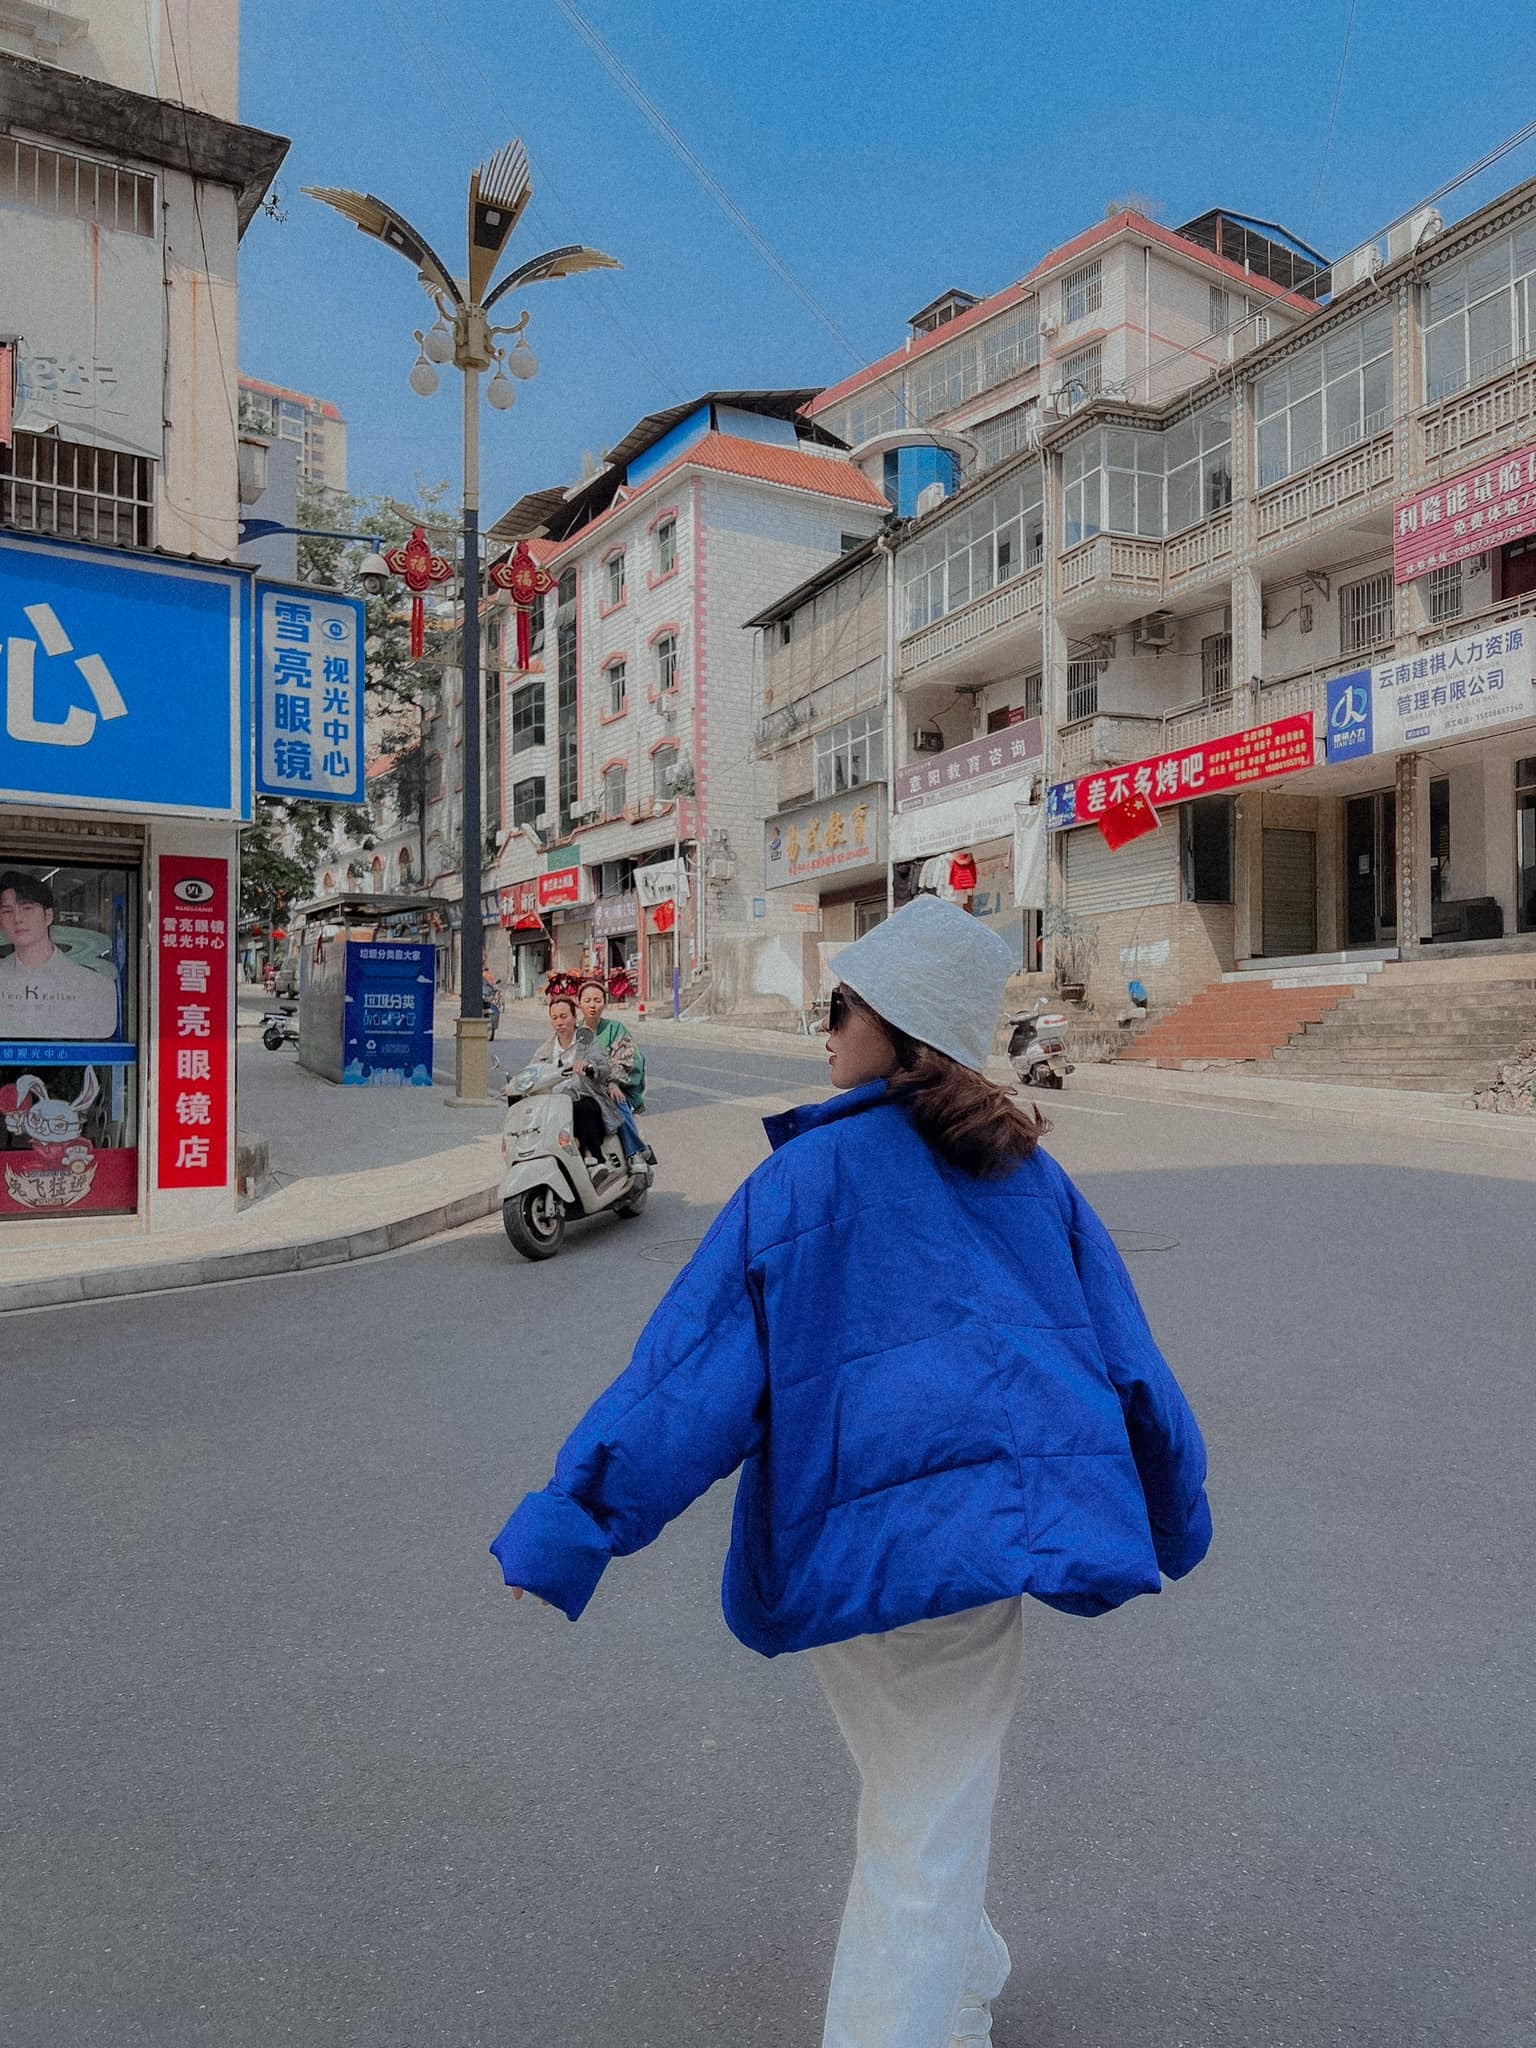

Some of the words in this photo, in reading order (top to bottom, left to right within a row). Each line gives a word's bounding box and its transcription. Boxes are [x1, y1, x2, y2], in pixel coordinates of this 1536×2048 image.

[410, 554, 427, 573] 福
[515, 569, 532, 587] 福
[0, 603, 128, 747] 心
[1379, 627, 1524, 690] 云南建祺人力资源
[274, 600, 312, 781] 雪亮眼镜
[322, 655, 351, 777] 视光中心
[1397, 668, 1505, 717] 管理有限公司
[1088, 751, 1206, 813] 差不多烤吧
[163, 917, 225, 934] 雪亮眼镜
[163, 933, 225, 949] 视光中心
[363, 993, 416, 1009] 垃圾分类
[175, 959, 212, 1169] 雪亮眼镜店
